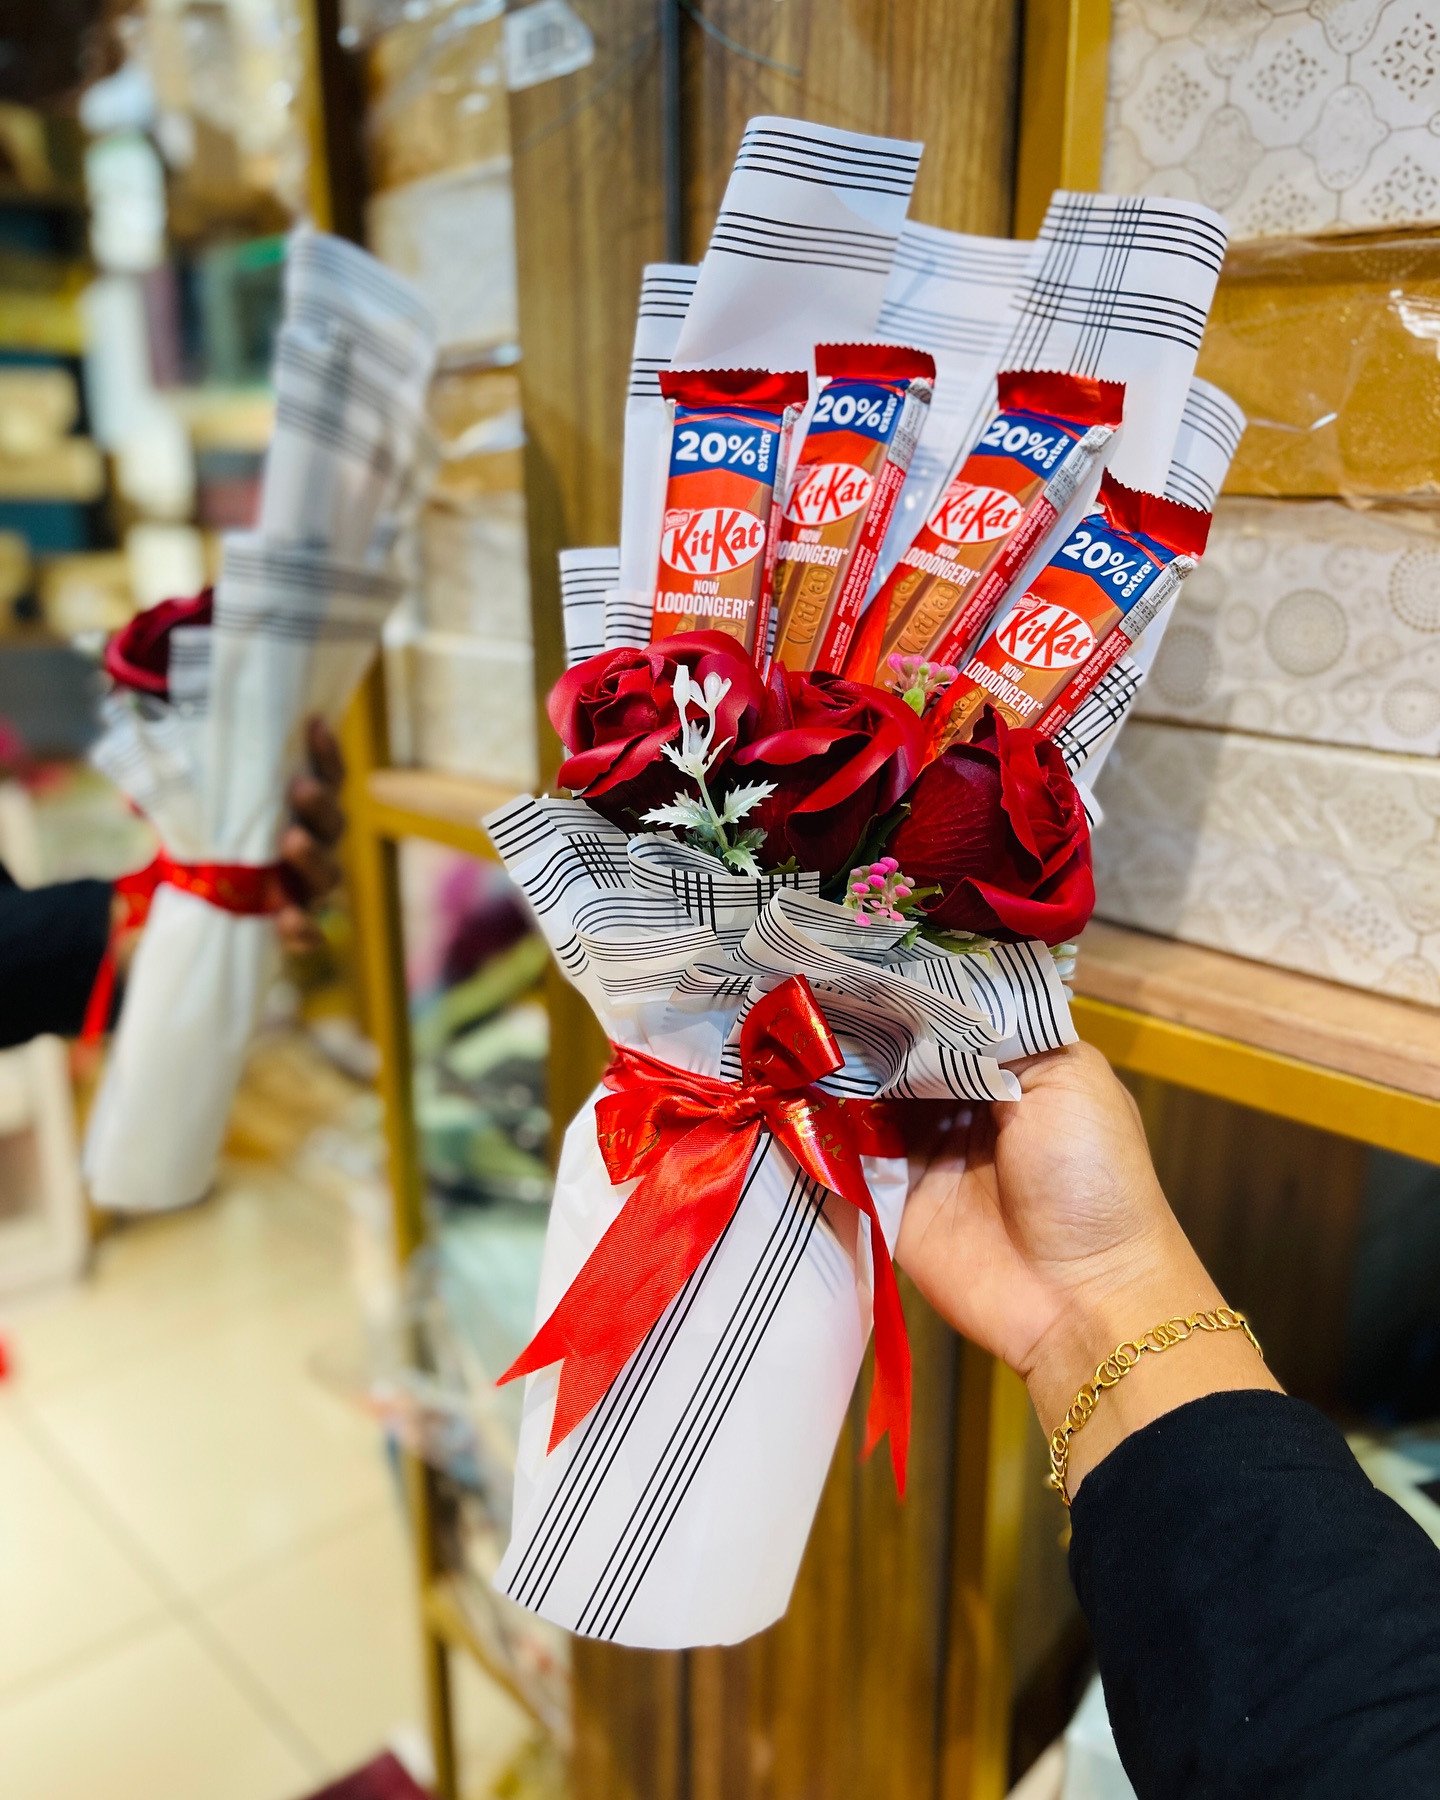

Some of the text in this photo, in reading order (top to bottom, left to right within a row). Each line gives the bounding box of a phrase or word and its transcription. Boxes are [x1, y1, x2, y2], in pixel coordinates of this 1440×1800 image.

[812, 394, 882, 428] 20%
[675, 431, 756, 465] 20%
[983, 420, 1055, 462] 20%
[785, 467, 872, 522] KitKat
[930, 489, 1019, 541] KitKat
[671, 509, 760, 572] KitKat
[797, 528, 822, 543] NOW
[935, 543, 960, 560] NOW
[1061, 531, 1136, 586] 20%
[693, 579, 719, 594] NOW
[999, 605, 1092, 667] KitKat
[1000, 661, 1025, 683] NOW
